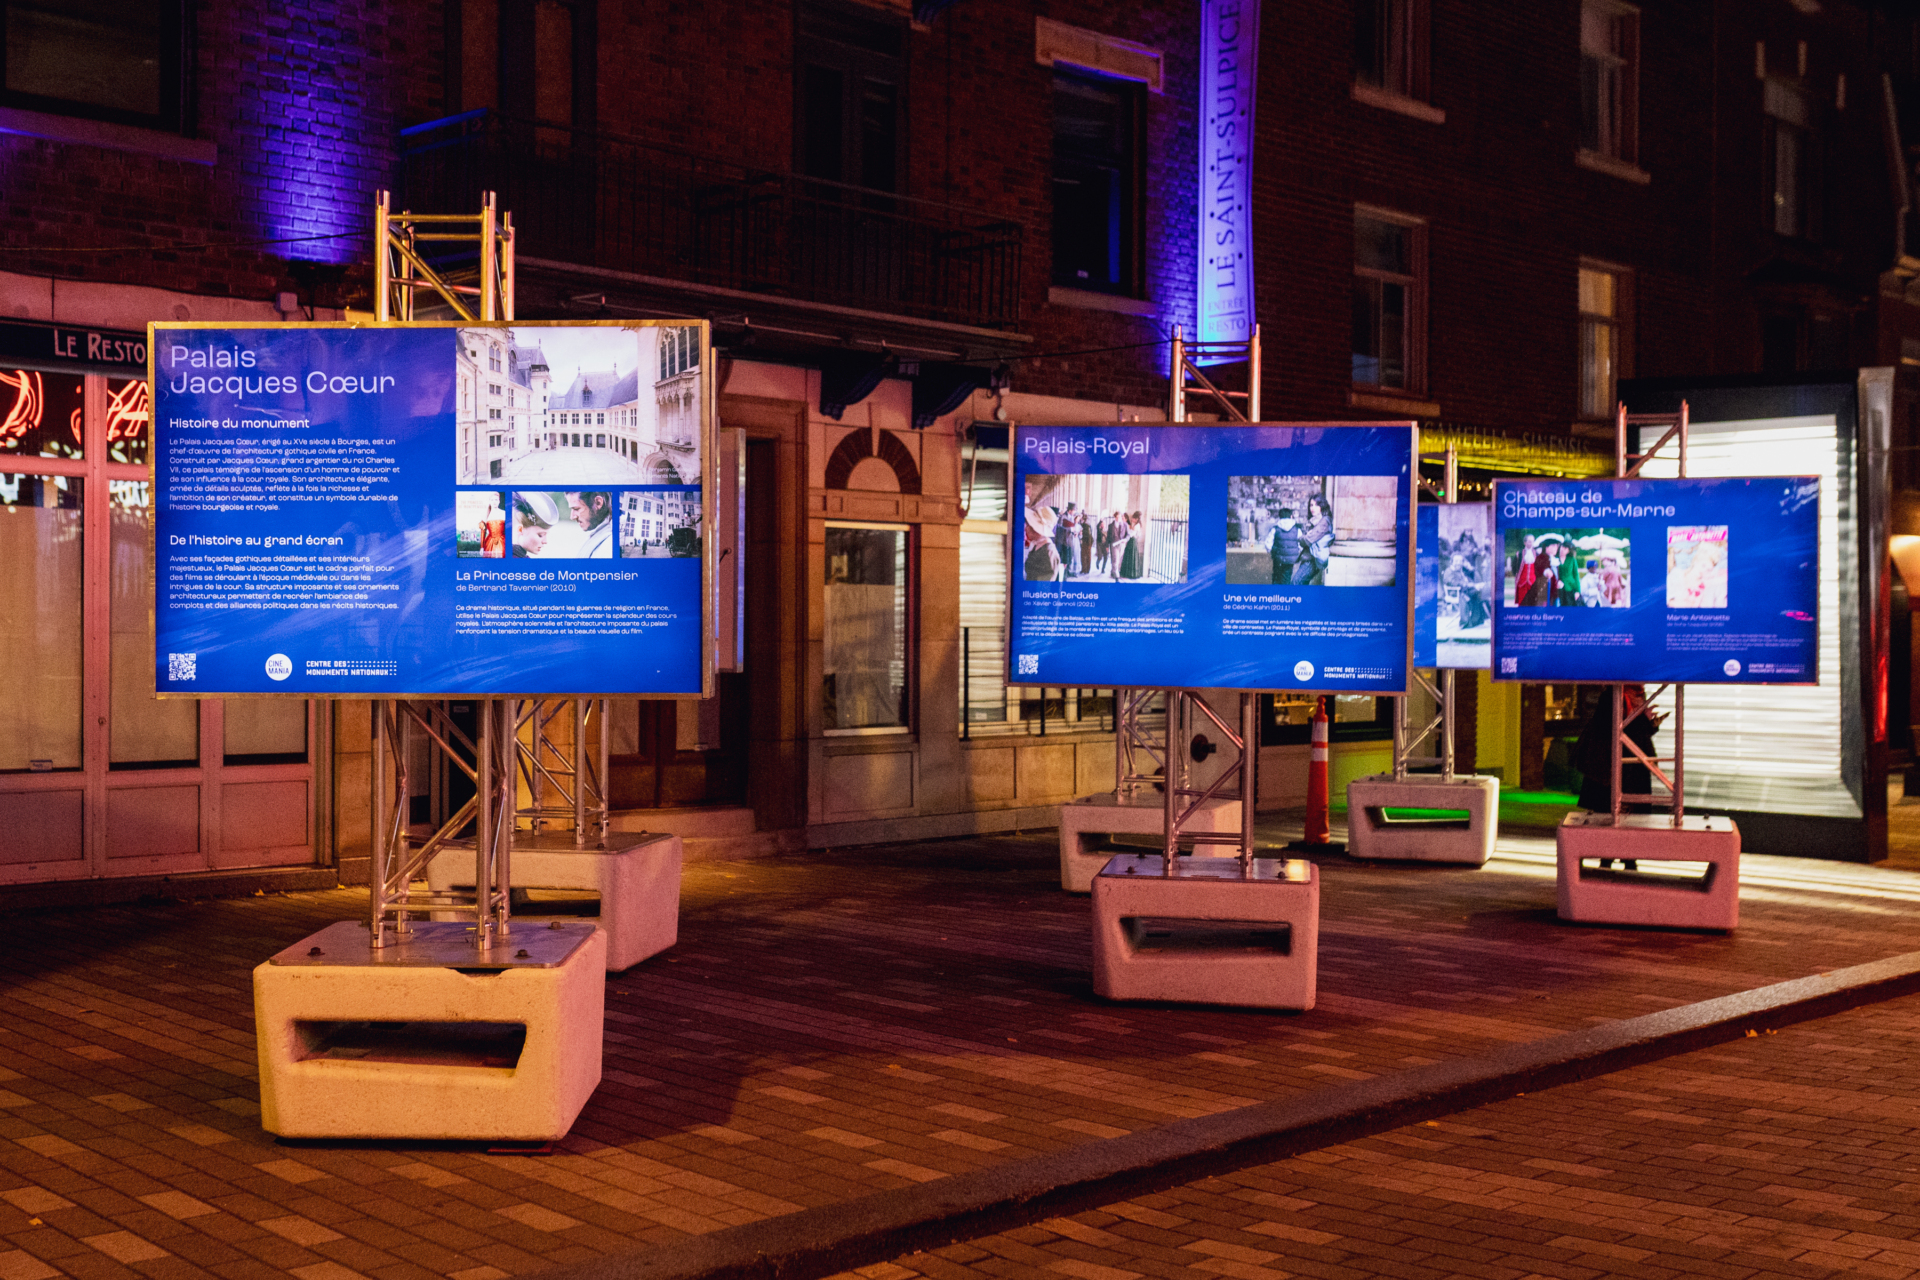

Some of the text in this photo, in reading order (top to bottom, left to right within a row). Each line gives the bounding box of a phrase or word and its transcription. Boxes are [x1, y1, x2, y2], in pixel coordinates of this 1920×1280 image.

[1216, 1, 1241, 290] LE SAINT-SULPICE
[1208, 297, 1245, 312] ENTRÉE
[1208, 318, 1245, 333] RESTO
[54, 329, 146, 364] LE RESTO
[171, 344, 256, 368] Palais
[170, 371, 395, 399] Jacques Cœur
[170, 418, 310, 428] Histoire du monument
[261, 438, 281, 447] érigé
[337, 438, 371, 447] Bourges,
[1025, 437, 1149, 459] Palais-Royal
[284, 448, 317, 456] gothique
[281, 457, 304, 465] grand
[215, 467, 250, 475] témoigne
[1504, 490, 1602, 504] Château de
[1504, 503, 1675, 520] Champs-sur-Marne
[170, 535, 343, 548] De l'histoire au grand écran
[204, 555, 234, 564] façades
[235, 555, 272, 564] gothiques
[456, 570, 638, 583] La Princesse de Montpensier
[550, 584, 576, 592] (2010)
[1060, 591, 1099, 600] Perdues
[1223, 594, 1242, 602] Une
[1259, 594, 1302, 603] meilleure
